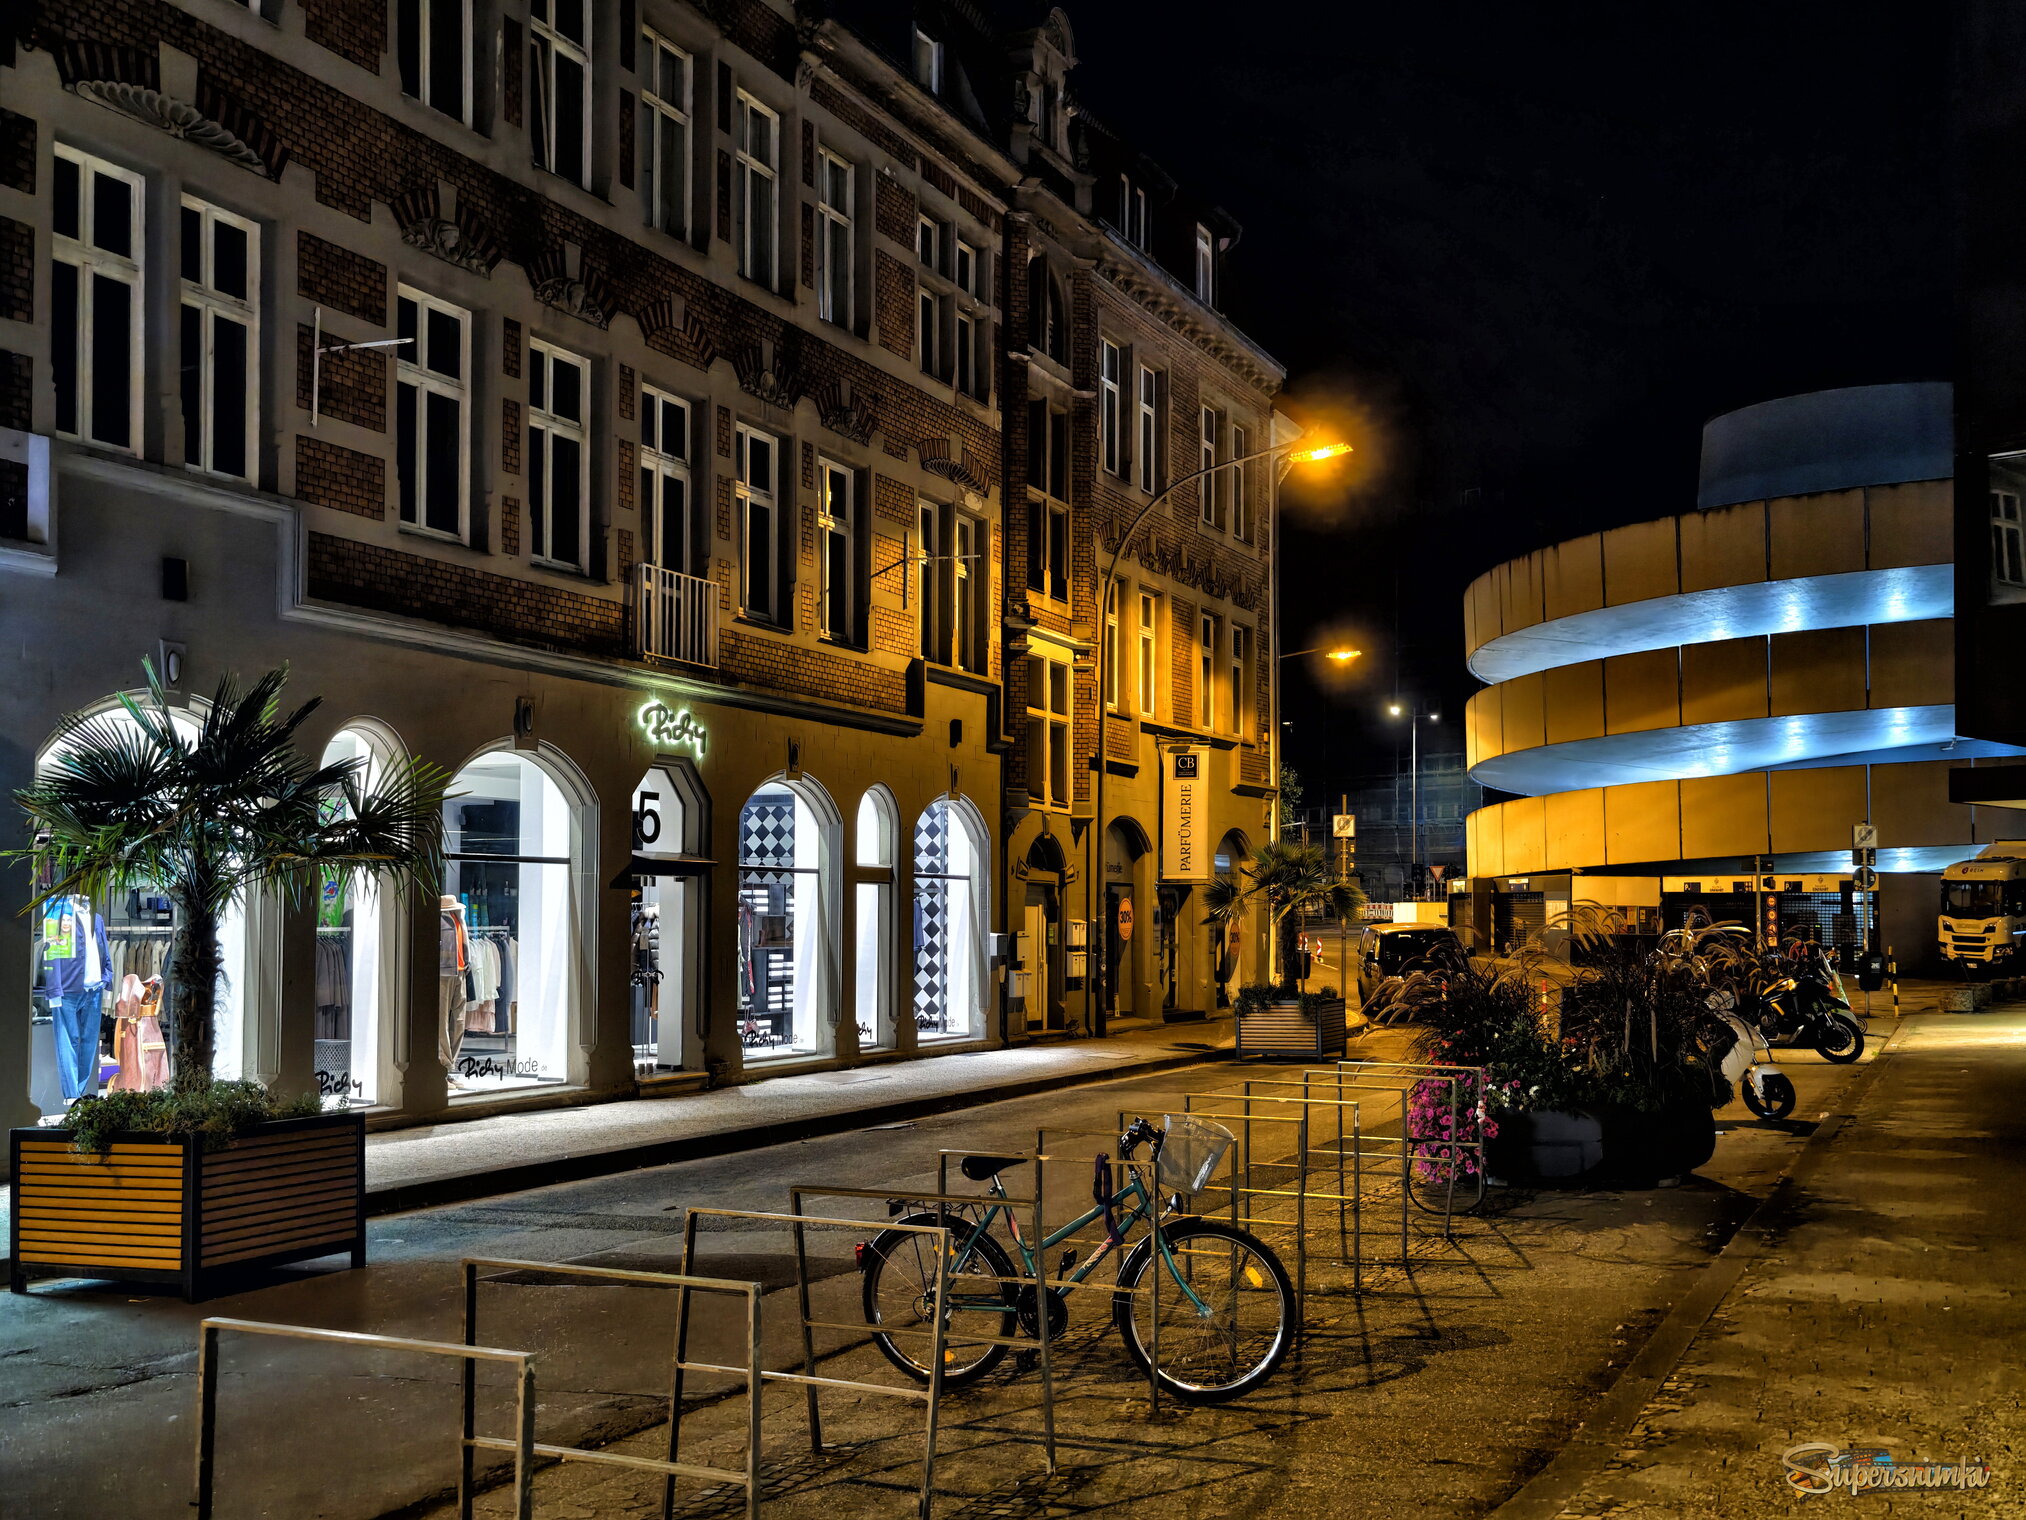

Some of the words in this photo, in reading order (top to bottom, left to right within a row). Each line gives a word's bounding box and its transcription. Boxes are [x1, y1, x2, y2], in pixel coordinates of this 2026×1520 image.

[641, 702, 707, 754] Richy
[1177, 756, 1195, 769] CB
[636, 791, 661, 844] 5
[1178, 784, 1192, 872] PARFÜMERIE
[1119, 910, 1132, 924] 30%
[1230, 931, 1241, 944] 30%
[857, 1022, 873, 1040] chy
[458, 1056, 503, 1081] Richy
[506, 1057, 539, 1075] Mode
[315, 1071, 363, 1098] Richy
